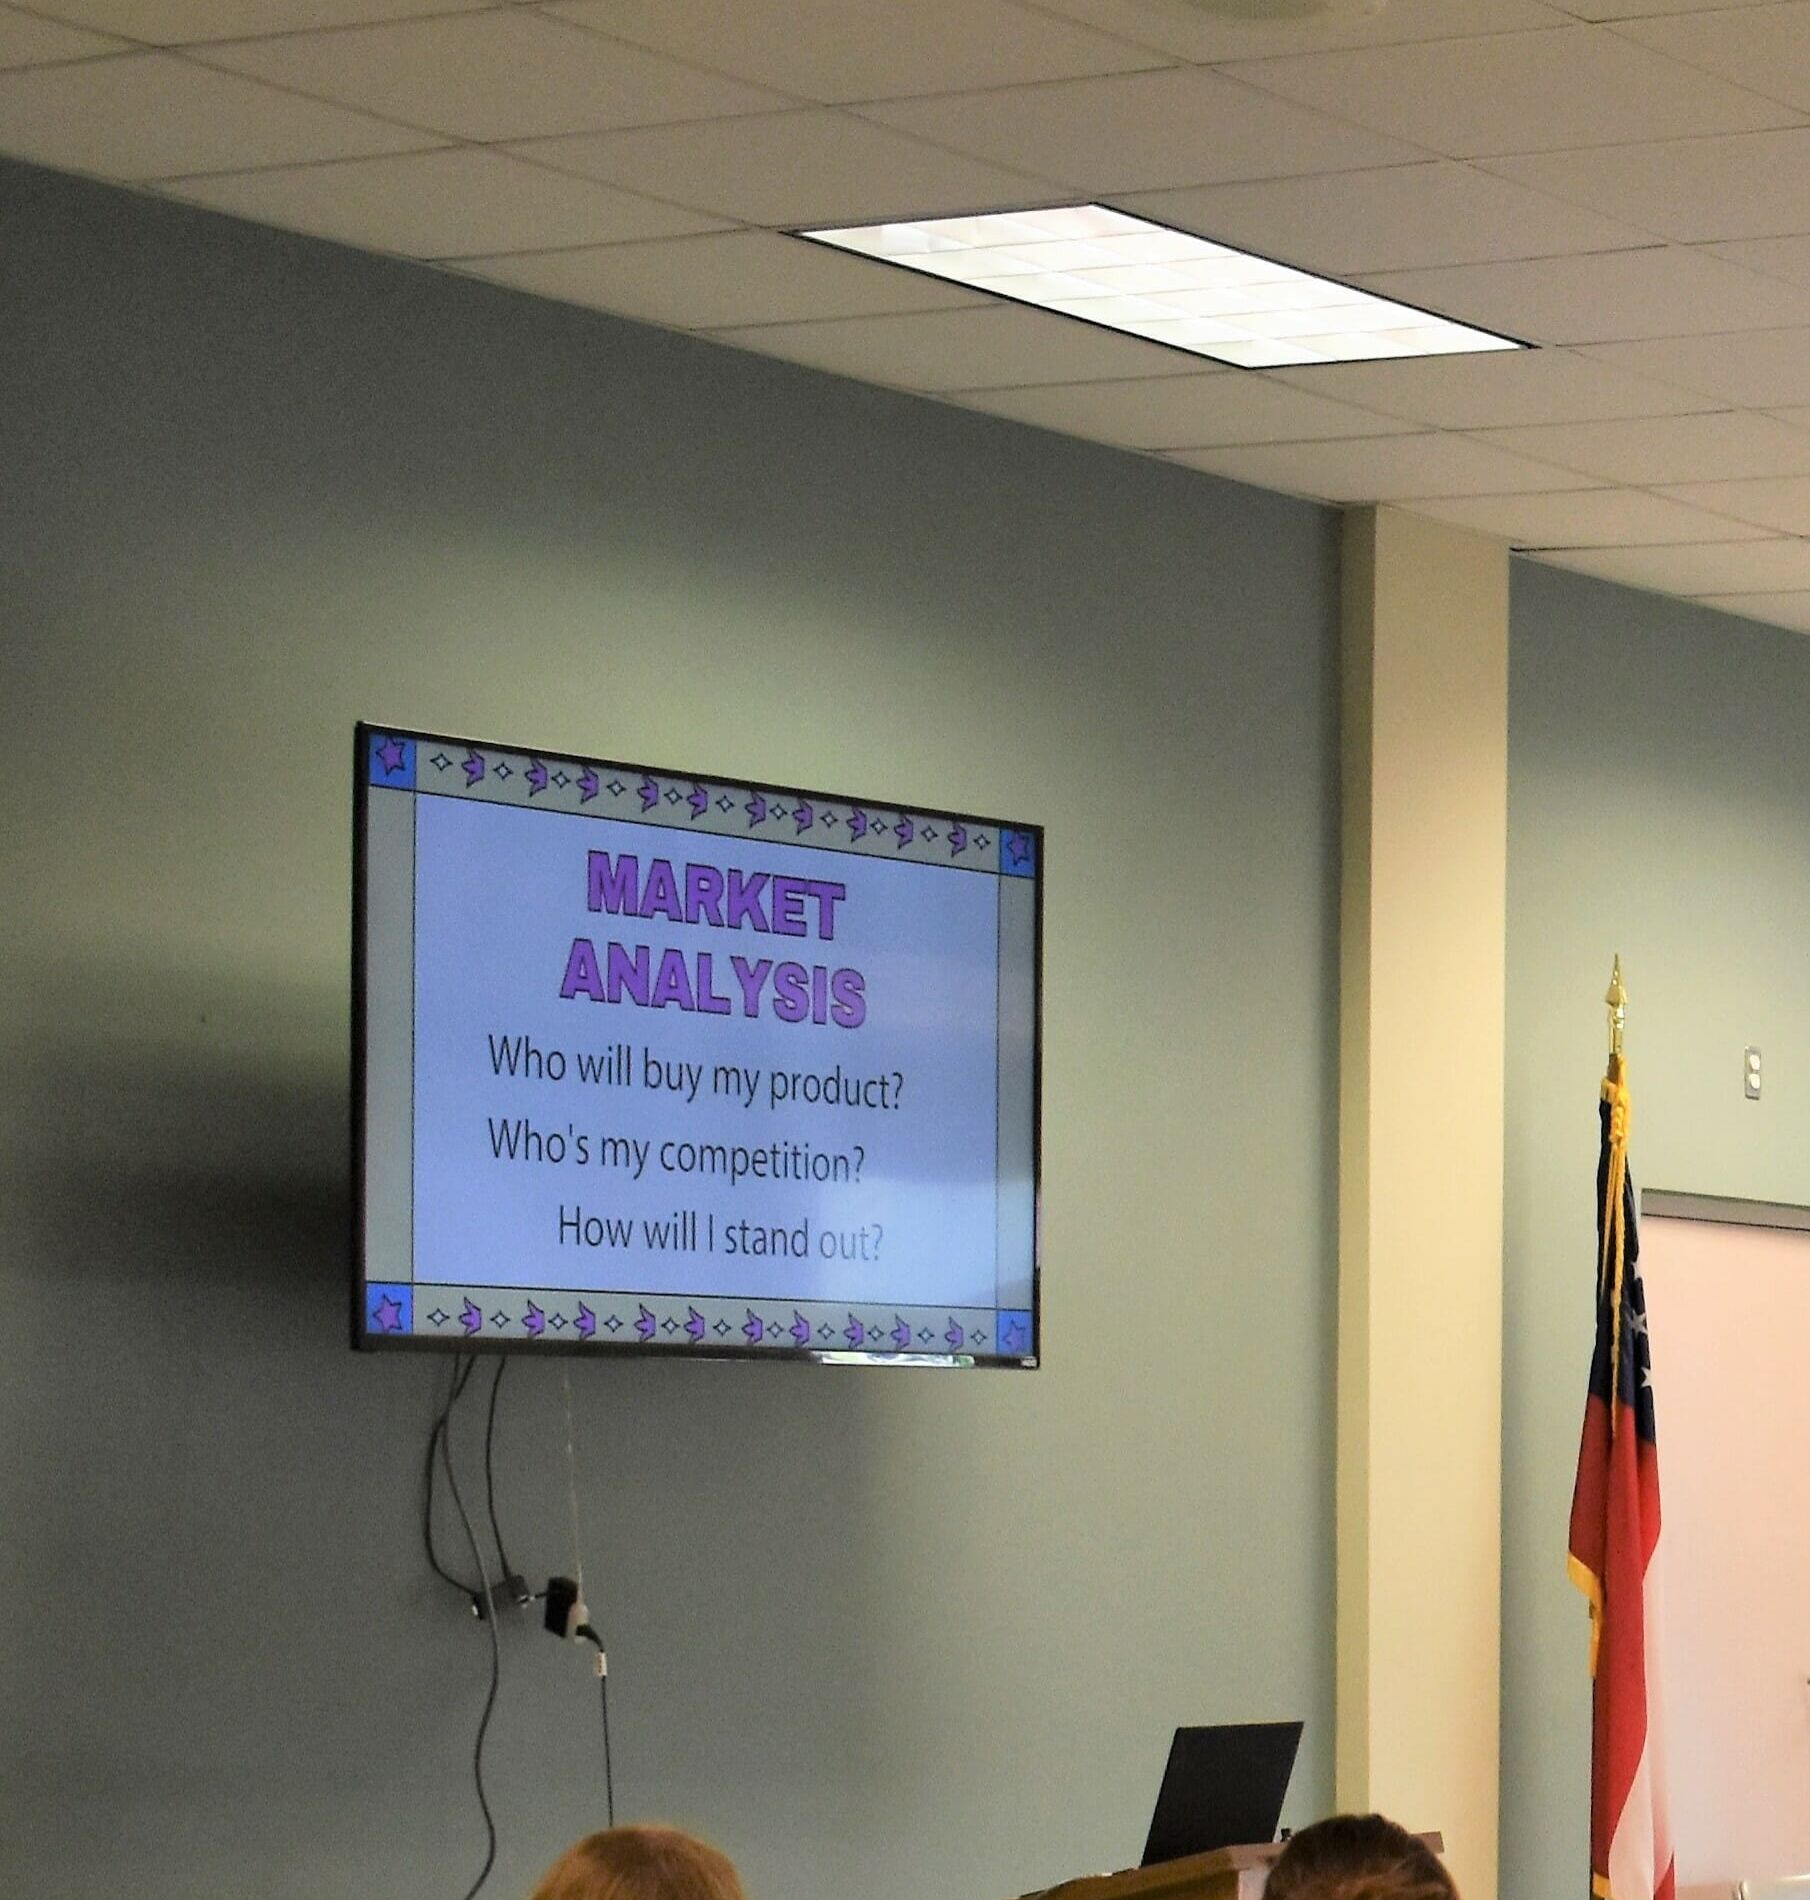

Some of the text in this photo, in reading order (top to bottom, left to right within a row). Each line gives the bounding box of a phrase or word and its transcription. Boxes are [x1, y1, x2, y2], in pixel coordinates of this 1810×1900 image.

[586, 850, 846, 941] MARKET
[560, 938, 867, 1029] ANALYSIS
[488, 1034, 904, 1110] Who will buy my product?
[488, 1117, 865, 1186] Who's my competition?
[559, 1204, 884, 1262] How will I stand out?
